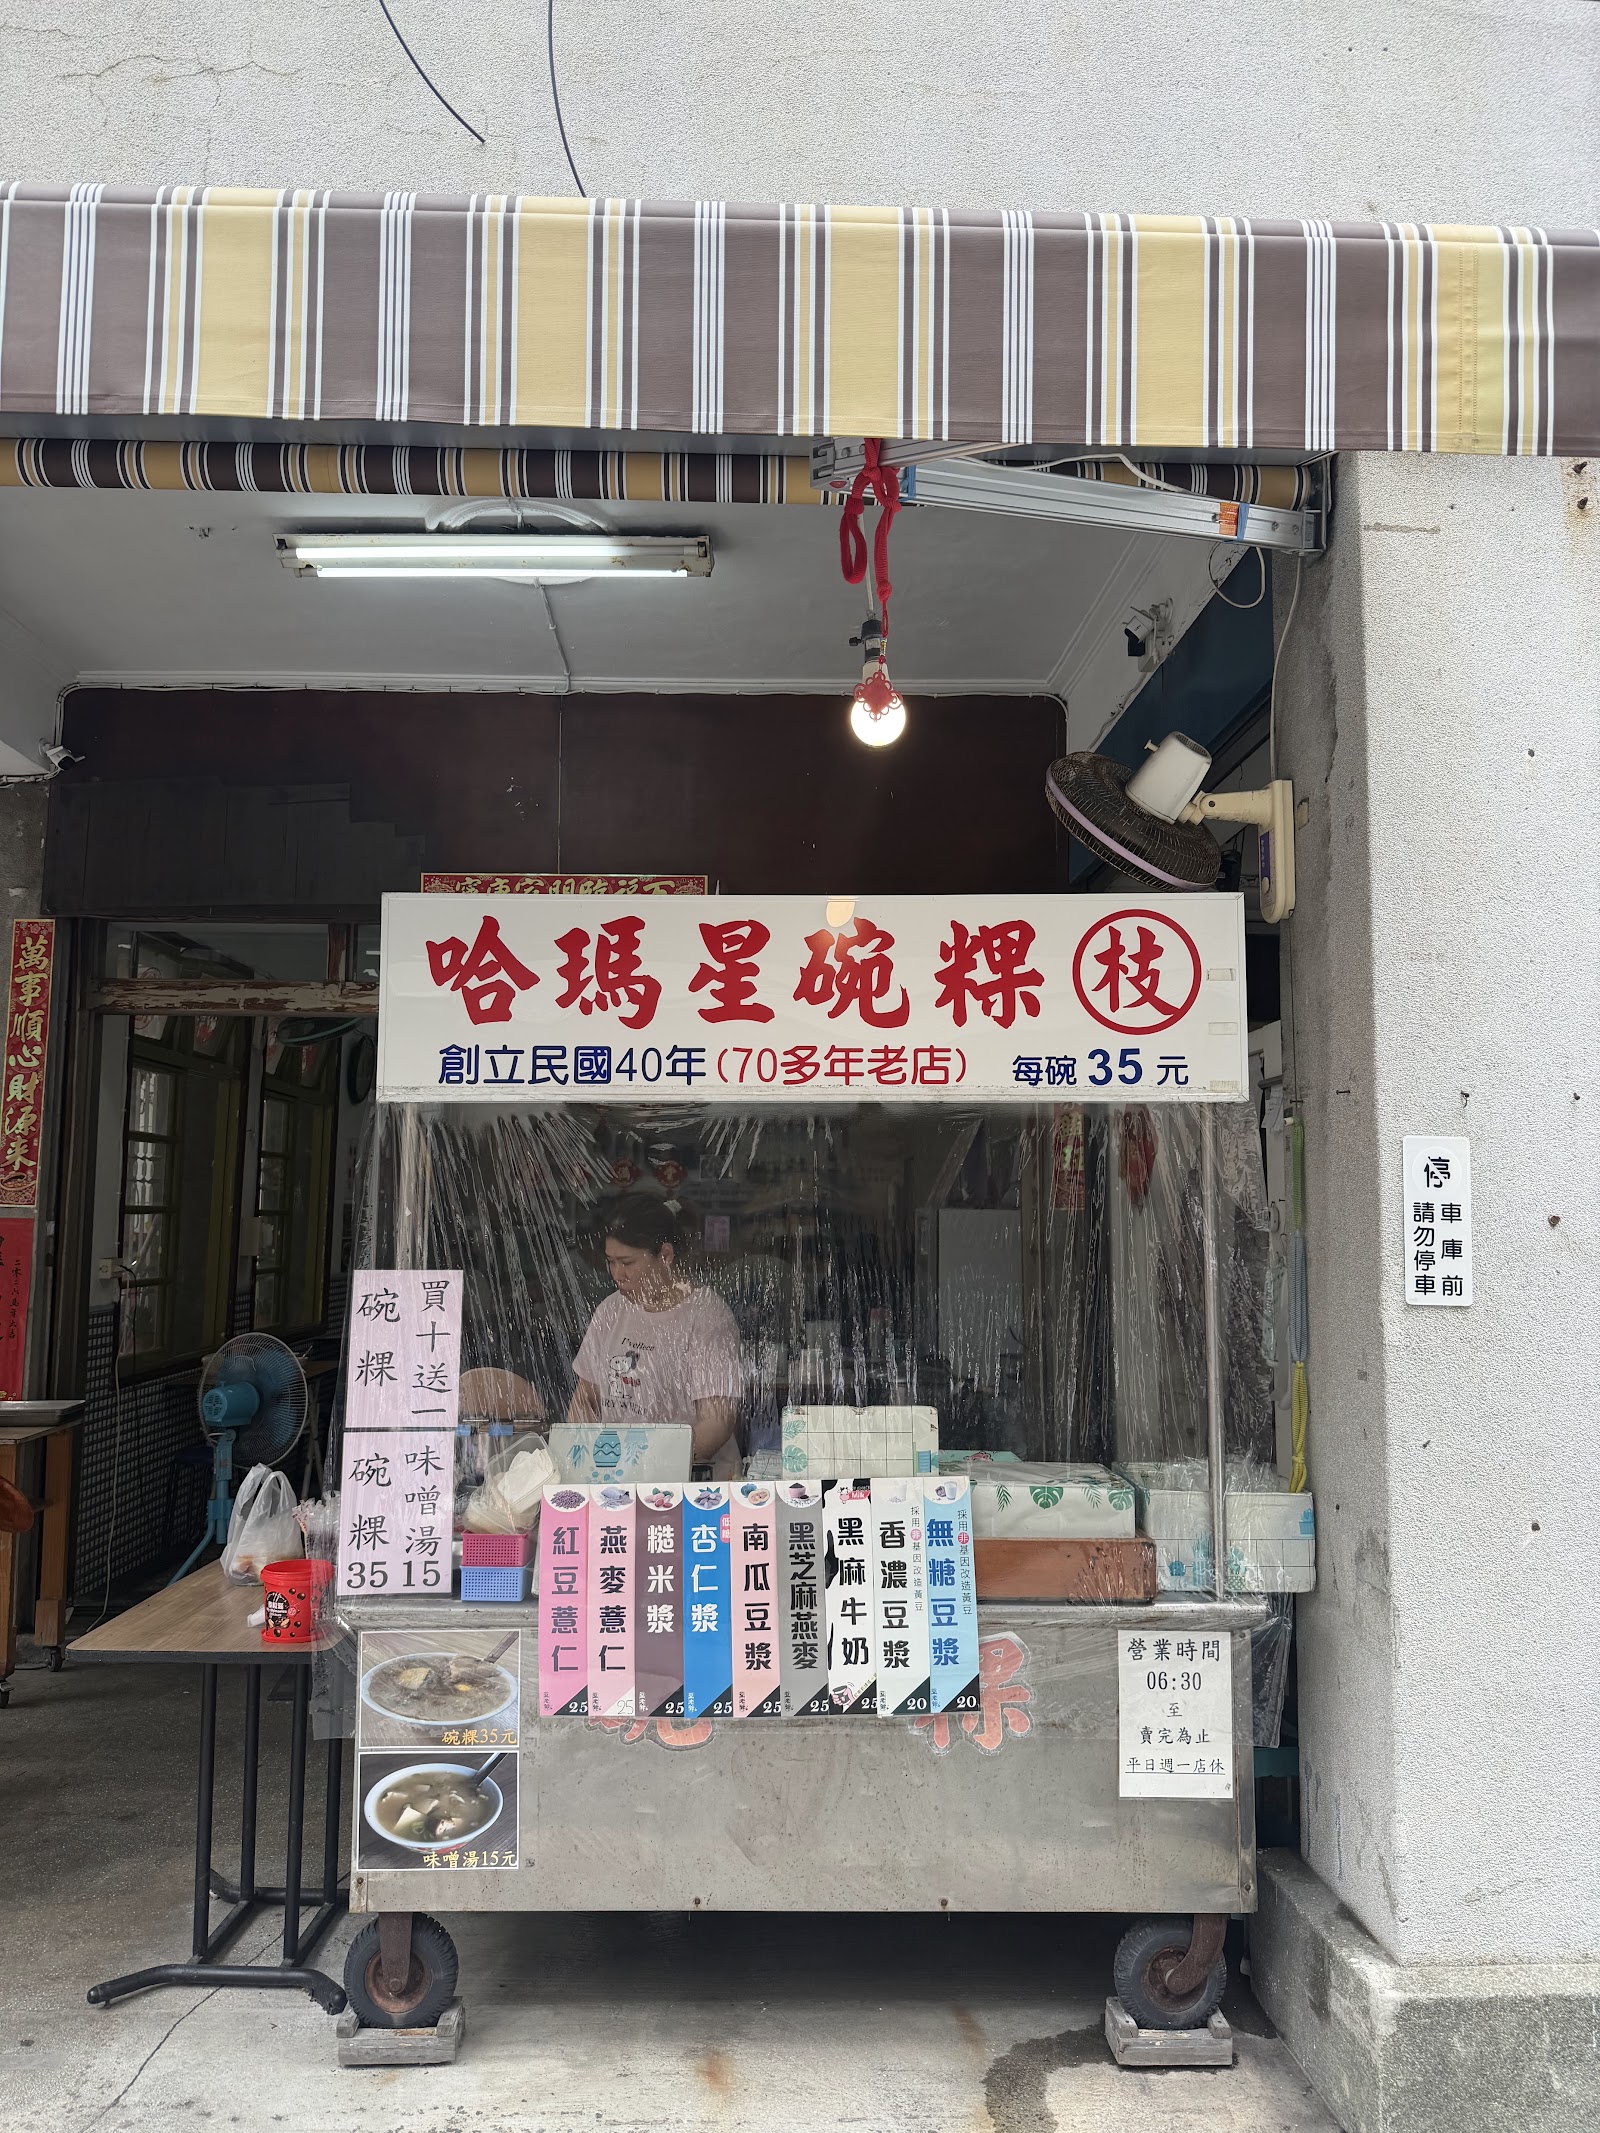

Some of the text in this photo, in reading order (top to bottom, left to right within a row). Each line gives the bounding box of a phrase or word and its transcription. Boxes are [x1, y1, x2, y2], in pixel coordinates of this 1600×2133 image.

[426, 914, 1044, 1030] 哈瑪星碗粿
[1095, 925, 1172, 1016] 枝
[1413, 1202, 1436, 1295] 請勿停車
[1440, 1202, 1464, 1296] 車庫前
[354, 1287, 400, 1387] 碗粿
[412, 1280, 451, 1415] 買十送一
[348, 1452, 392, 1551] 碗粿
[404, 1445, 444, 1556] 味噌湯
[346, 1560, 389, 1589] 35
[402, 1560, 441, 1587] 15
[647, 1524, 674, 1634] 糙米漿
[691, 1524, 718, 1633] 杏仁漿
[838, 1517, 869, 1666] 黑麻牛奶
[957, 1508, 973, 1615] 採用非基因改造黃豆
[552, 1526, 579, 1672] 紅豆薏仁
[599, 1525, 628, 1672] 燕麥薏仁
[742, 1523, 772, 1671] 南瓜豆漿
[788, 1521, 819, 1670] 黑芝麻燕麥
[880, 1520, 911, 1669] 香濃豆漿
[927, 1518, 960, 1666] 無糖豆漿
[1127, 1638, 1220, 1662] 營業時間
[569, 1700, 588, 1713] 25
[617, 1700, 634, 1714] 25
[665, 1701, 685, 1713] 25
[713, 1701, 733, 1714] 25
[763, 1701, 782, 1713] 25
[810, 1700, 829, 1712] 25
[861, 1697, 878, 1709] 25
[907, 1698, 927, 1710] 20
[956, 1696, 977, 1708] 20
[1146, 1671, 1202, 1691] 06:30
[1167, 1702, 1183, 1718] 至
[441, 1728, 517, 1745] 碗粿35元
[1126, 1757, 1225, 1773] 平日週一店休
[1140, 1726, 1211, 1745] 賣完為止
[423, 1850, 518, 1869] 味噌湯15元
